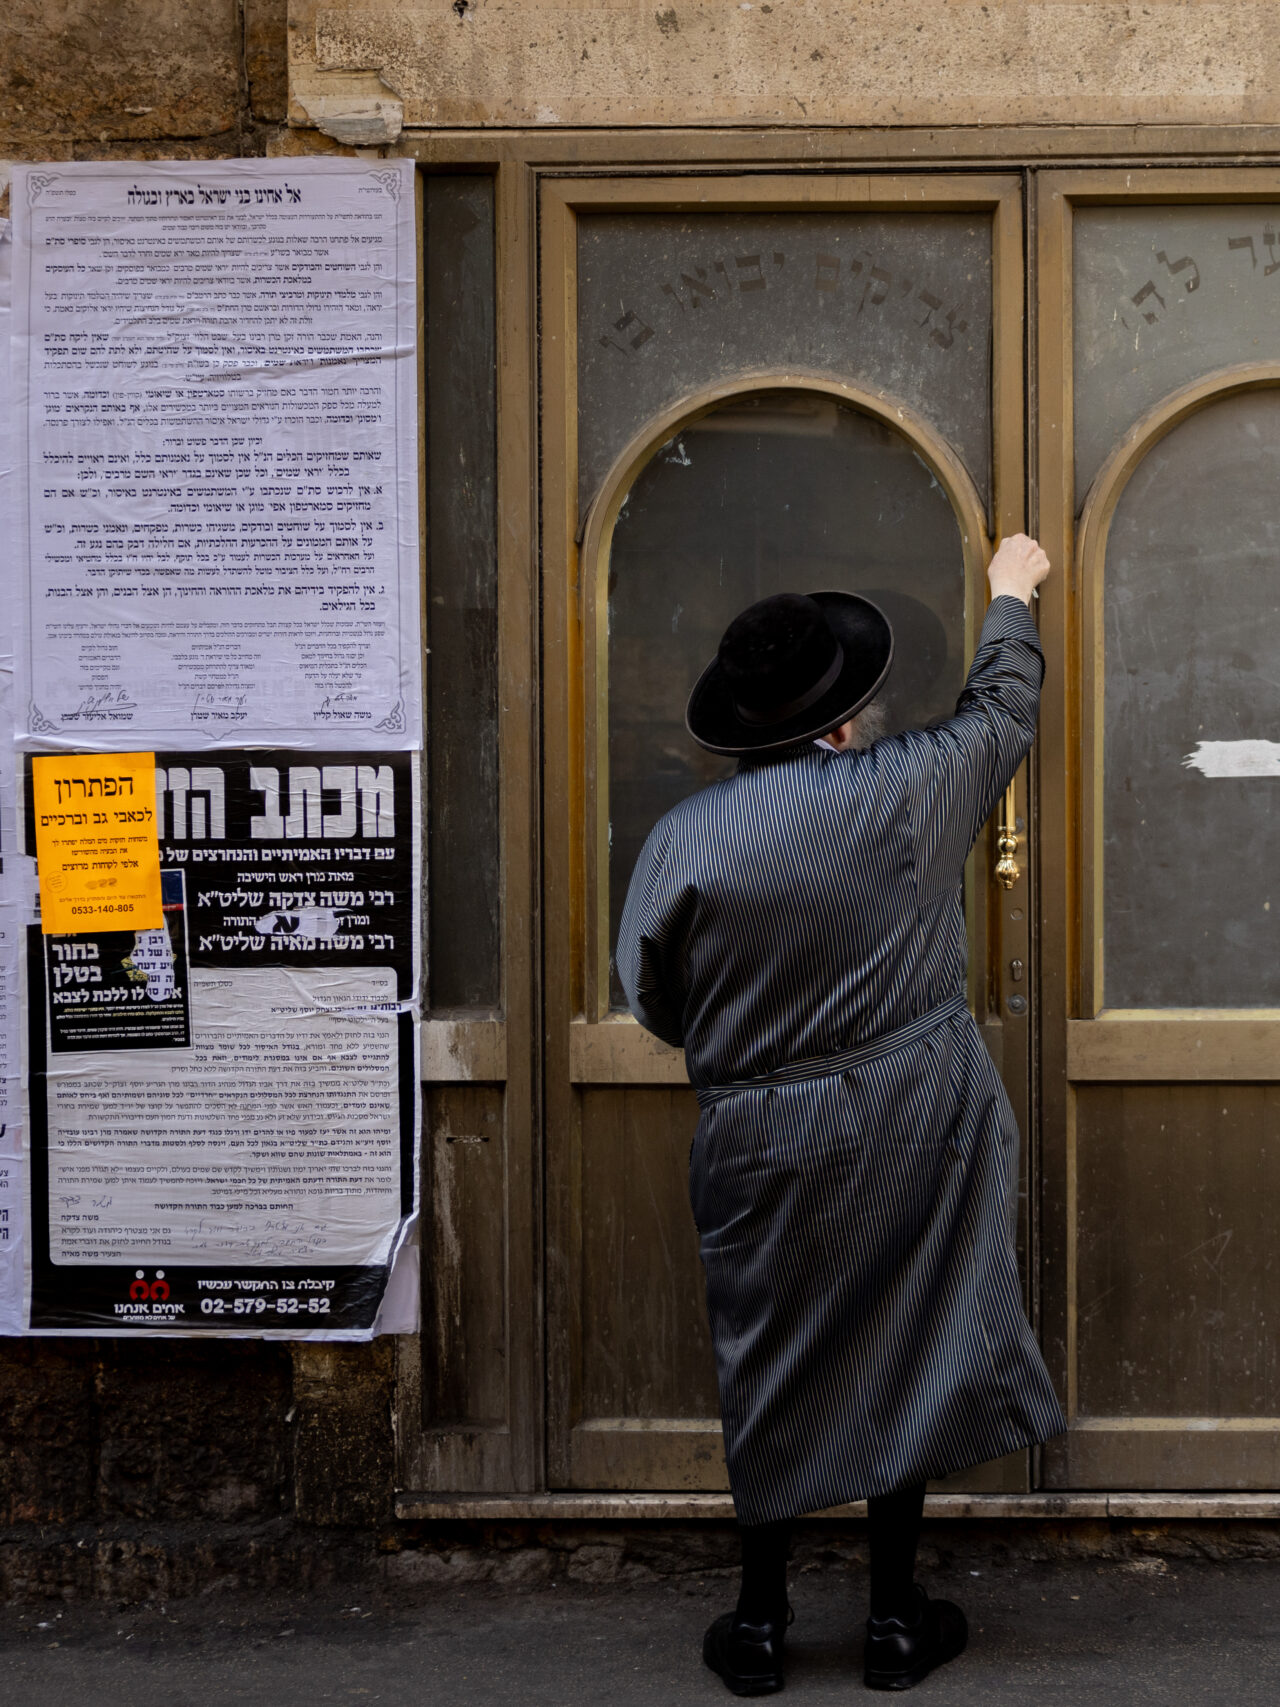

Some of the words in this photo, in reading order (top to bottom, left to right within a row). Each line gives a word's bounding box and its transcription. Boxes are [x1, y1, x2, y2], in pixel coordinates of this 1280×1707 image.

[127, 184, 161, 205] ובגולה
[165, 190, 194, 206] בארץ
[197, 183, 231, 204] ישראל
[235, 189, 251, 204] בני
[254, 188, 282, 203] אחינו
[285, 188, 301, 203] אל
[659, 250, 786, 312] יבואו
[815, 251, 969, 350] צדיקים
[598, 310, 655, 356] בו
[319, 602, 356, 610] הגילאים.
[359, 601, 375, 610] בכל
[190, 712, 209, 720] שטרן
[230, 712, 247, 720] יעקב
[313, 711, 331, 720] קליין
[332, 710, 352, 719] שאול
[354, 711, 372, 719] משה
[53, 776, 133, 804] הפתרון
[249, 765, 395, 839] מכתב
[40, 813, 87, 826] וברכיים
[92, 812, 108, 824] גב
[113, 806, 152, 822] לכאבי
[166, 848, 189, 862] של
[192, 848, 258, 861] והנחרצים
[261, 848, 331, 861] האמיתיים
[334, 847, 371, 860] דבריו
[374, 847, 395, 860] עם
[237, 872, 276, 882] הישיבה
[278, 872, 303, 882] ראש
[305, 872, 325, 884] מרן
[327, 871, 354, 881] מאת
[198, 890, 265, 908] שליט"א
[269, 891, 315, 910] צדקה
[320, 891, 365, 906] משה
[368, 890, 395, 906] רבי
[71, 903, 134, 915] 0533-140-805
[199, 935, 266, 952] שליט"א
[271, 934, 315, 951] מאיה
[318, 934, 365, 950] משה
[368, 934, 395, 950] רבי
[51, 942, 99, 960] בחור
[53, 964, 102, 987] בטלן
[53, 988, 89, 1004] לצבא
[92, 986, 128, 1002] ללכת
[197, 1280, 232, 1289] עכשיו
[233, 1280, 279, 1291] התקשר
[281, 1280, 295, 1289] צו
[297, 1278, 335, 1291] קיבלת
[114, 1303, 149, 1313] אנחנו
[152, 1303, 185, 1313] אחים
[200, 1297, 330, 1313] 02-579-52-52
